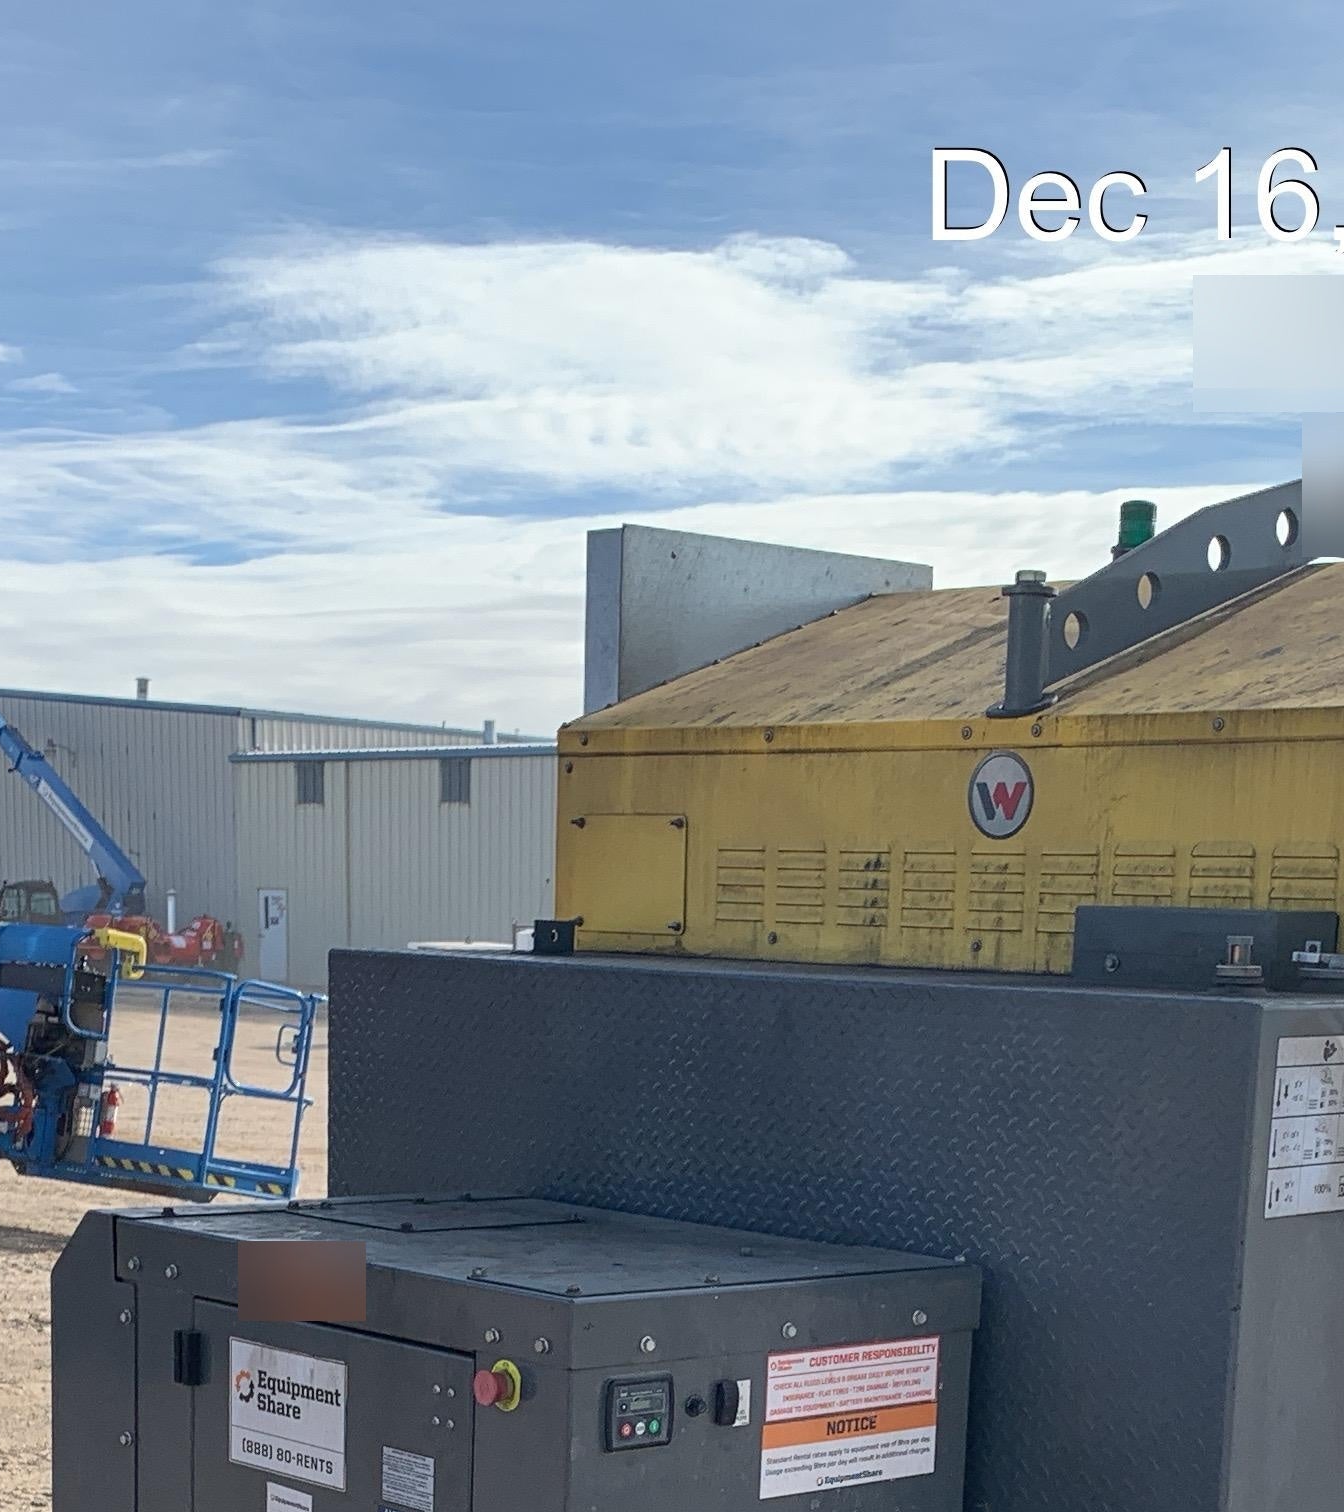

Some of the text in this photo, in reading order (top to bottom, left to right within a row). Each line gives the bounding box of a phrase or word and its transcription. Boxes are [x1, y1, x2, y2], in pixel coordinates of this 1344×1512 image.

[809, 1343, 937, 1368] CUSTOMER RESPONSIBILITY
[257, 1369, 342, 1407] Equipment
[773, 1382, 793, 1391] CHECK
[257, 1393, 301, 1419] Share
[803, 1401, 835, 1412] EQUIPMENT
[826, 1415, 878, 1436] NOTICE
[242, 1437, 334, 1475] (888) 80-RENTS
[767, 1455, 792, 1464] Standard
[828, 1448, 843, 1457] apply
[851, 1443, 879, 1453] equipment
[784, 1464, 813, 1473] exceeding
[824, 1469, 883, 1485] EquipmentShare
